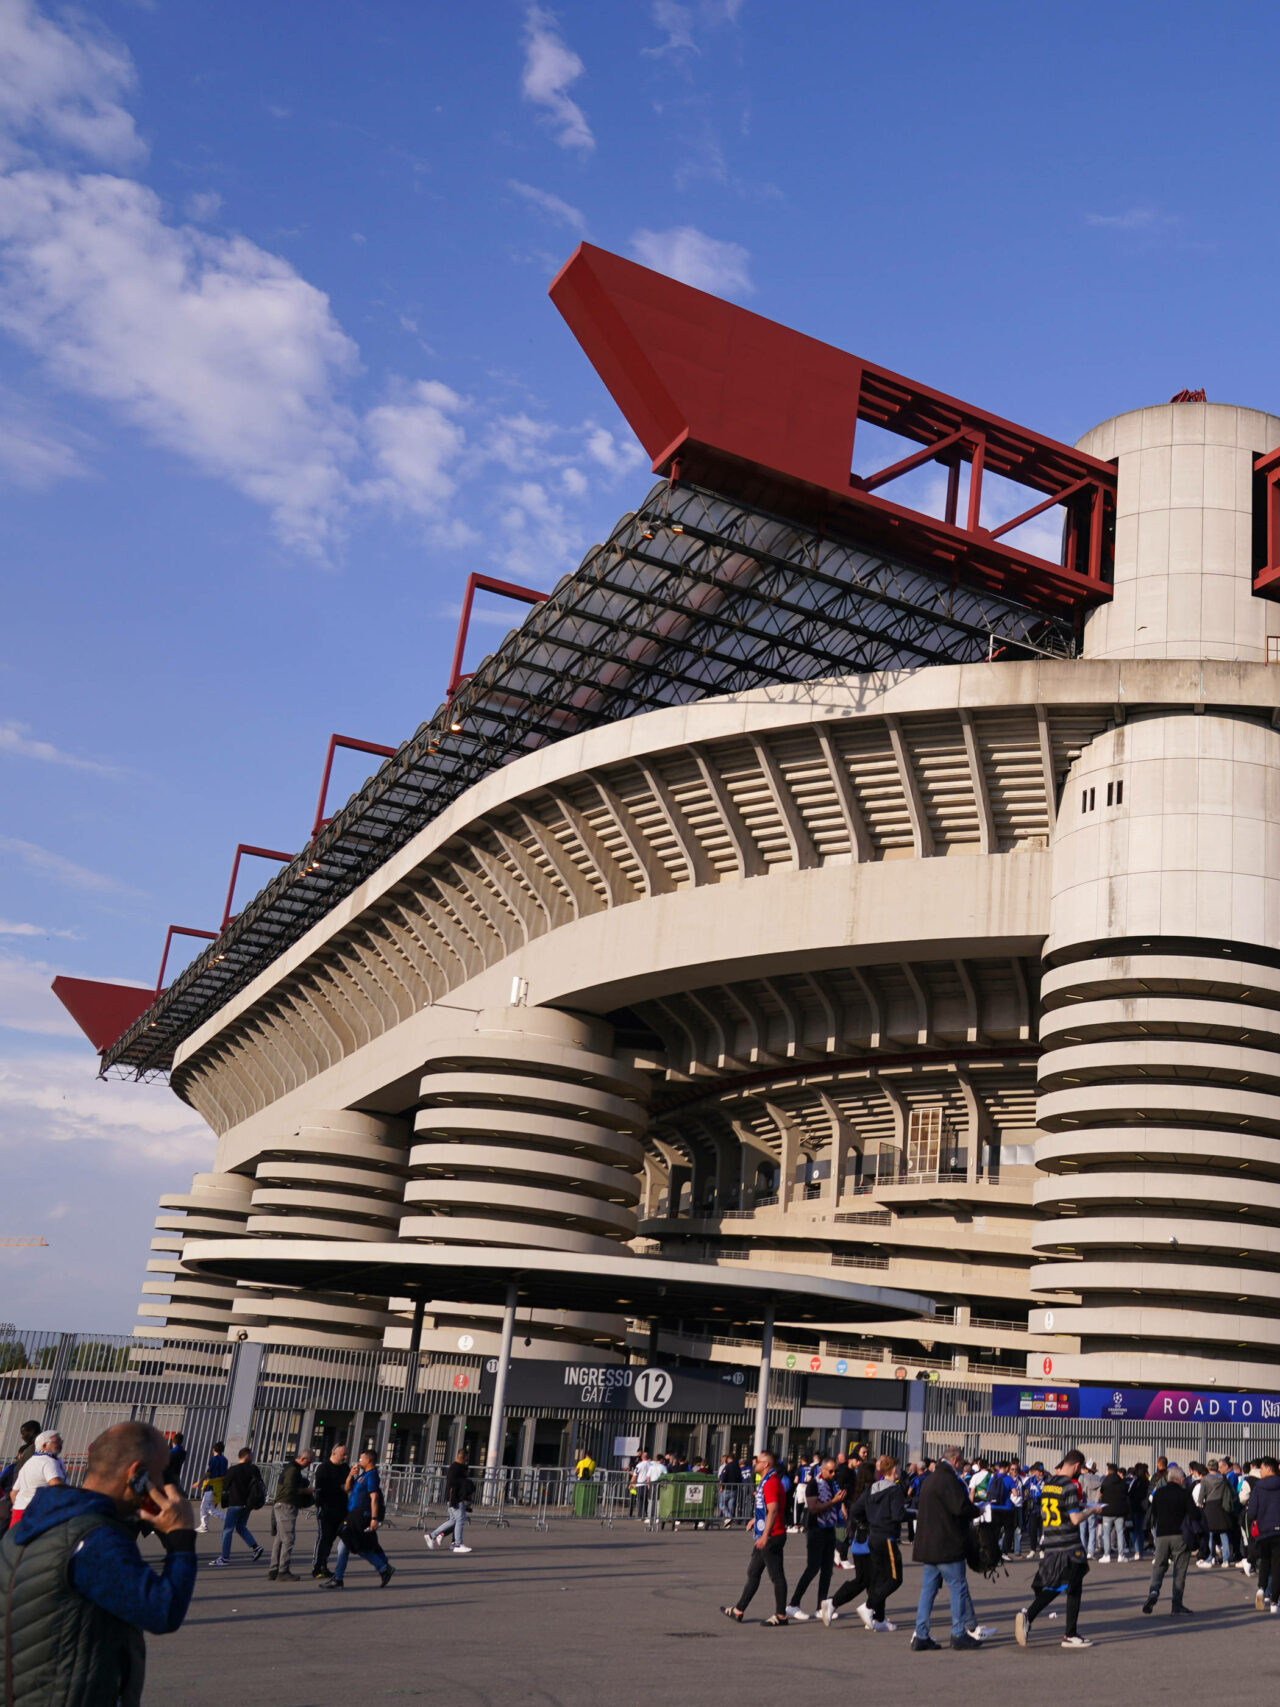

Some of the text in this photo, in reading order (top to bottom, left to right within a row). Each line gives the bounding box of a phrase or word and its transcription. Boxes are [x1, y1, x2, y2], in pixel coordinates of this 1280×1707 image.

[564, 1367, 633, 1387] INGRESSO
[581, 1386, 614, 1403] GATE
[641, 1373, 667, 1403] 12
[1163, 1398, 1220, 1416] ROAD
[1228, 1400, 1253, 1416] TO
[1041, 1498, 1062, 1527] 33
